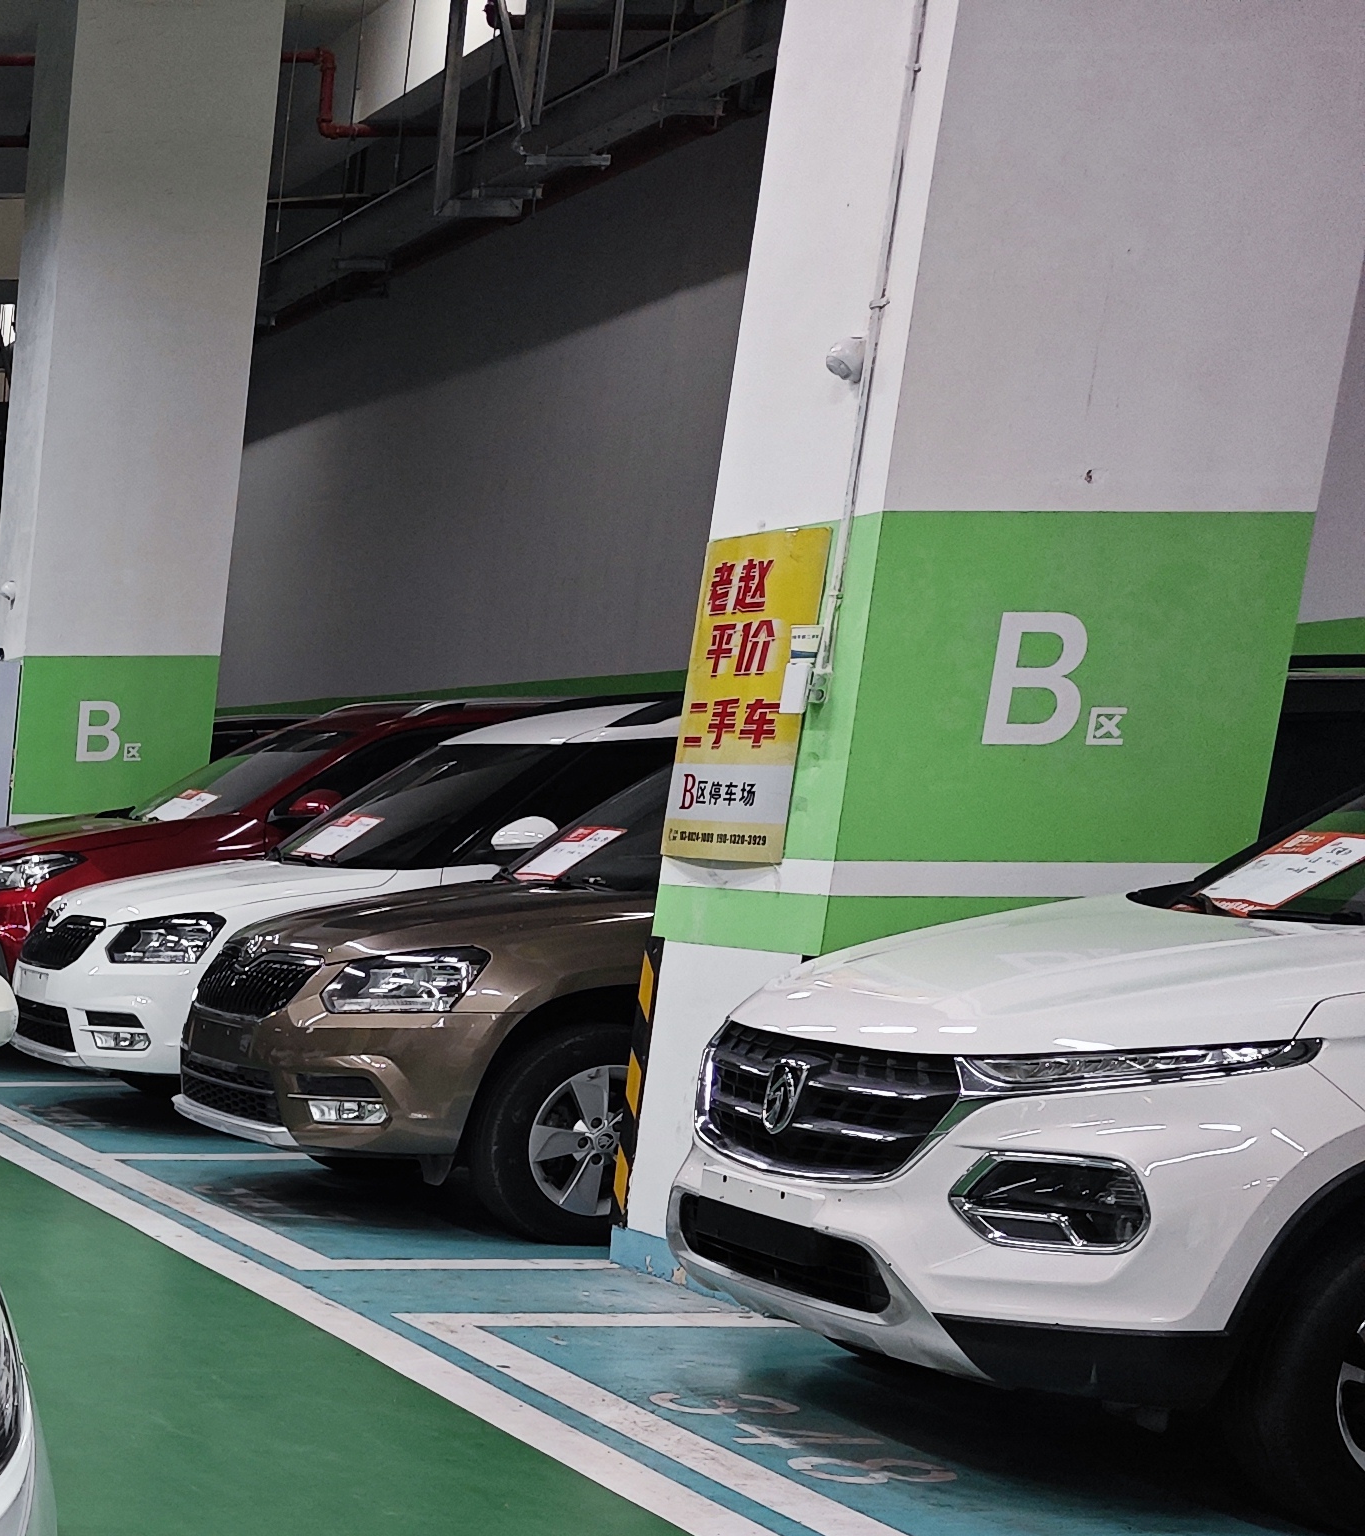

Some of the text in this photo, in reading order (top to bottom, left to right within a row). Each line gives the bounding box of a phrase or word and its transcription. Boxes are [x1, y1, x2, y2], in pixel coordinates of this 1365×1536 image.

[709, 558, 774, 616] 老赵
[706, 619, 776, 677] 平价
[981, 611, 1128, 745] B区
[75, 700, 141, 762] B区
[683, 697, 780, 749] 二手车
[679, 774, 756, 809] B区停车场
